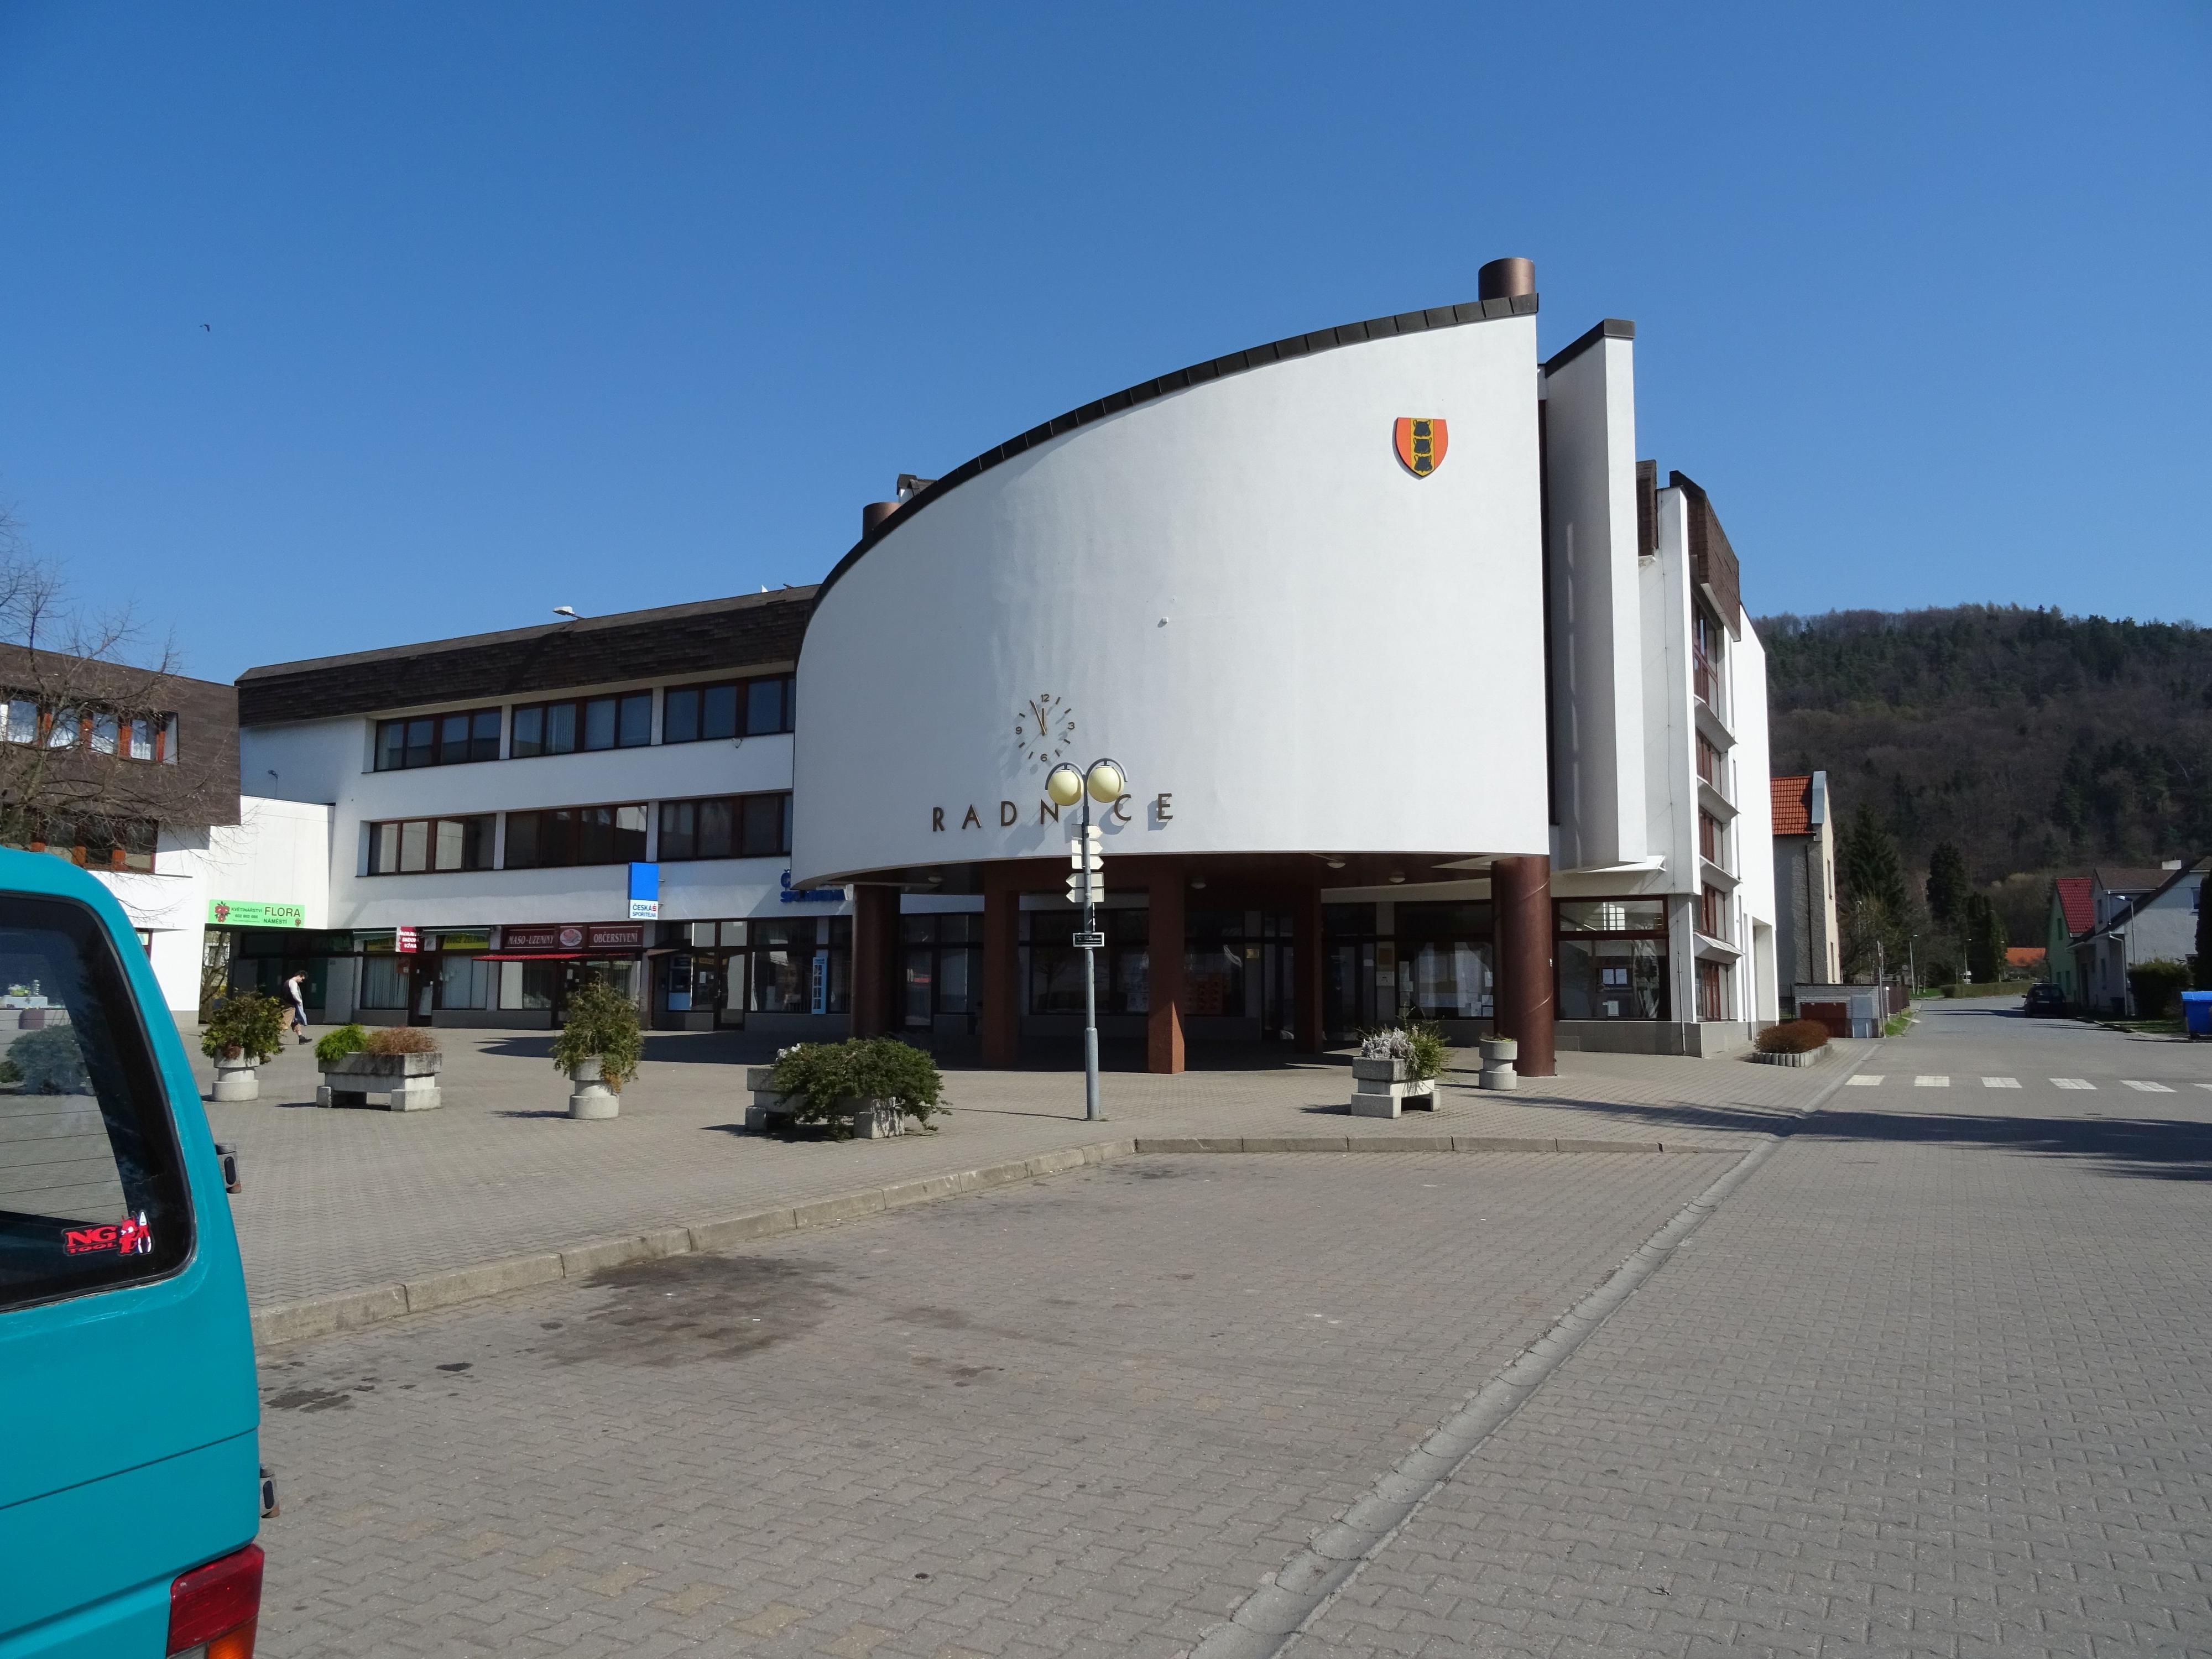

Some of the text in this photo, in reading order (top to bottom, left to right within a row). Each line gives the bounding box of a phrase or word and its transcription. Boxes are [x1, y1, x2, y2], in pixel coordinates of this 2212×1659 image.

[1040, 693, 1050, 702] 12
[1015, 726, 1022, 735] 9
[1067, 722, 1075, 730] 3
[1040, 753, 1047, 762] 6
[932, 792, 1173, 832] RADNCE
[264, 906, 301, 917] FLORA
[593, 930, 638, 943] OBČERSTVENÍ
[65, 1226, 118, 1246] NG
